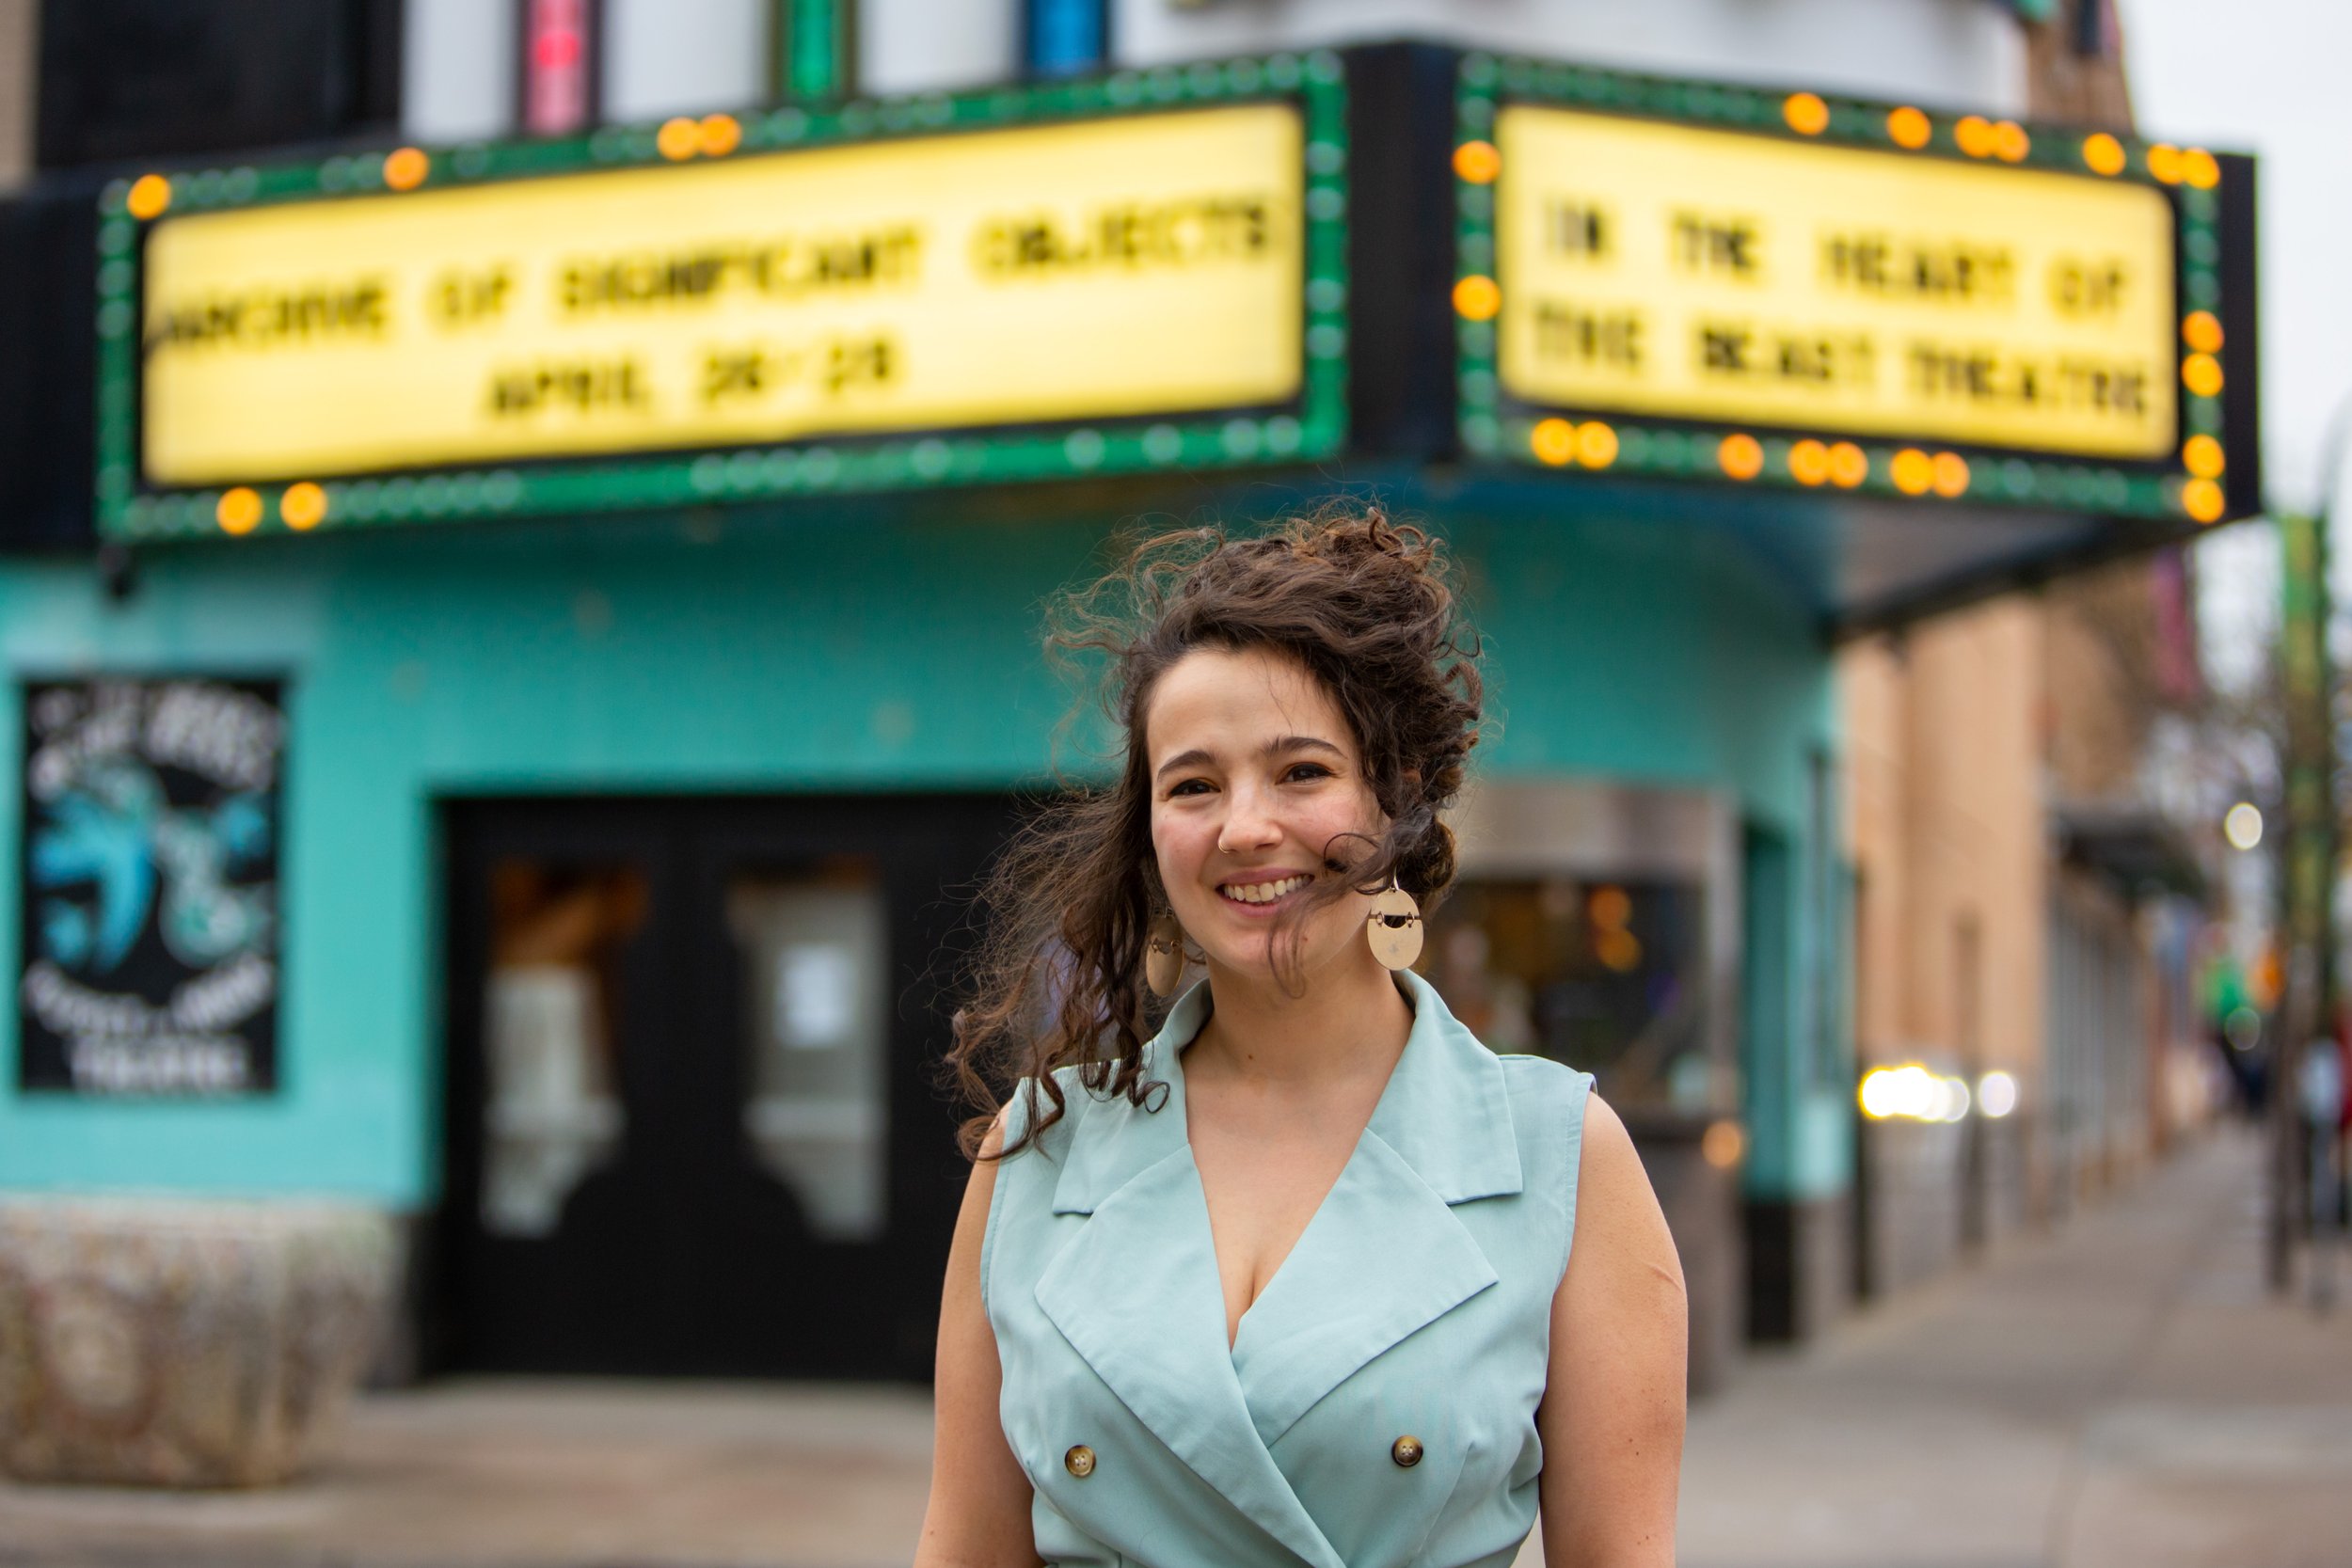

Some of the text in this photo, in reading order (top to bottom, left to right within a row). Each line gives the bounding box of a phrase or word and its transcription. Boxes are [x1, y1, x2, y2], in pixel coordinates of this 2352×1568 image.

[149, 196, 1274, 355] ARCHIVE OF SIGNIFICANT OBJECTS
[1547, 193, 2132, 320] IN THE HEART OF
[487, 356, 647, 420] APRIL
[1534, 298, 2156, 423] THE BEAST THEATRE
